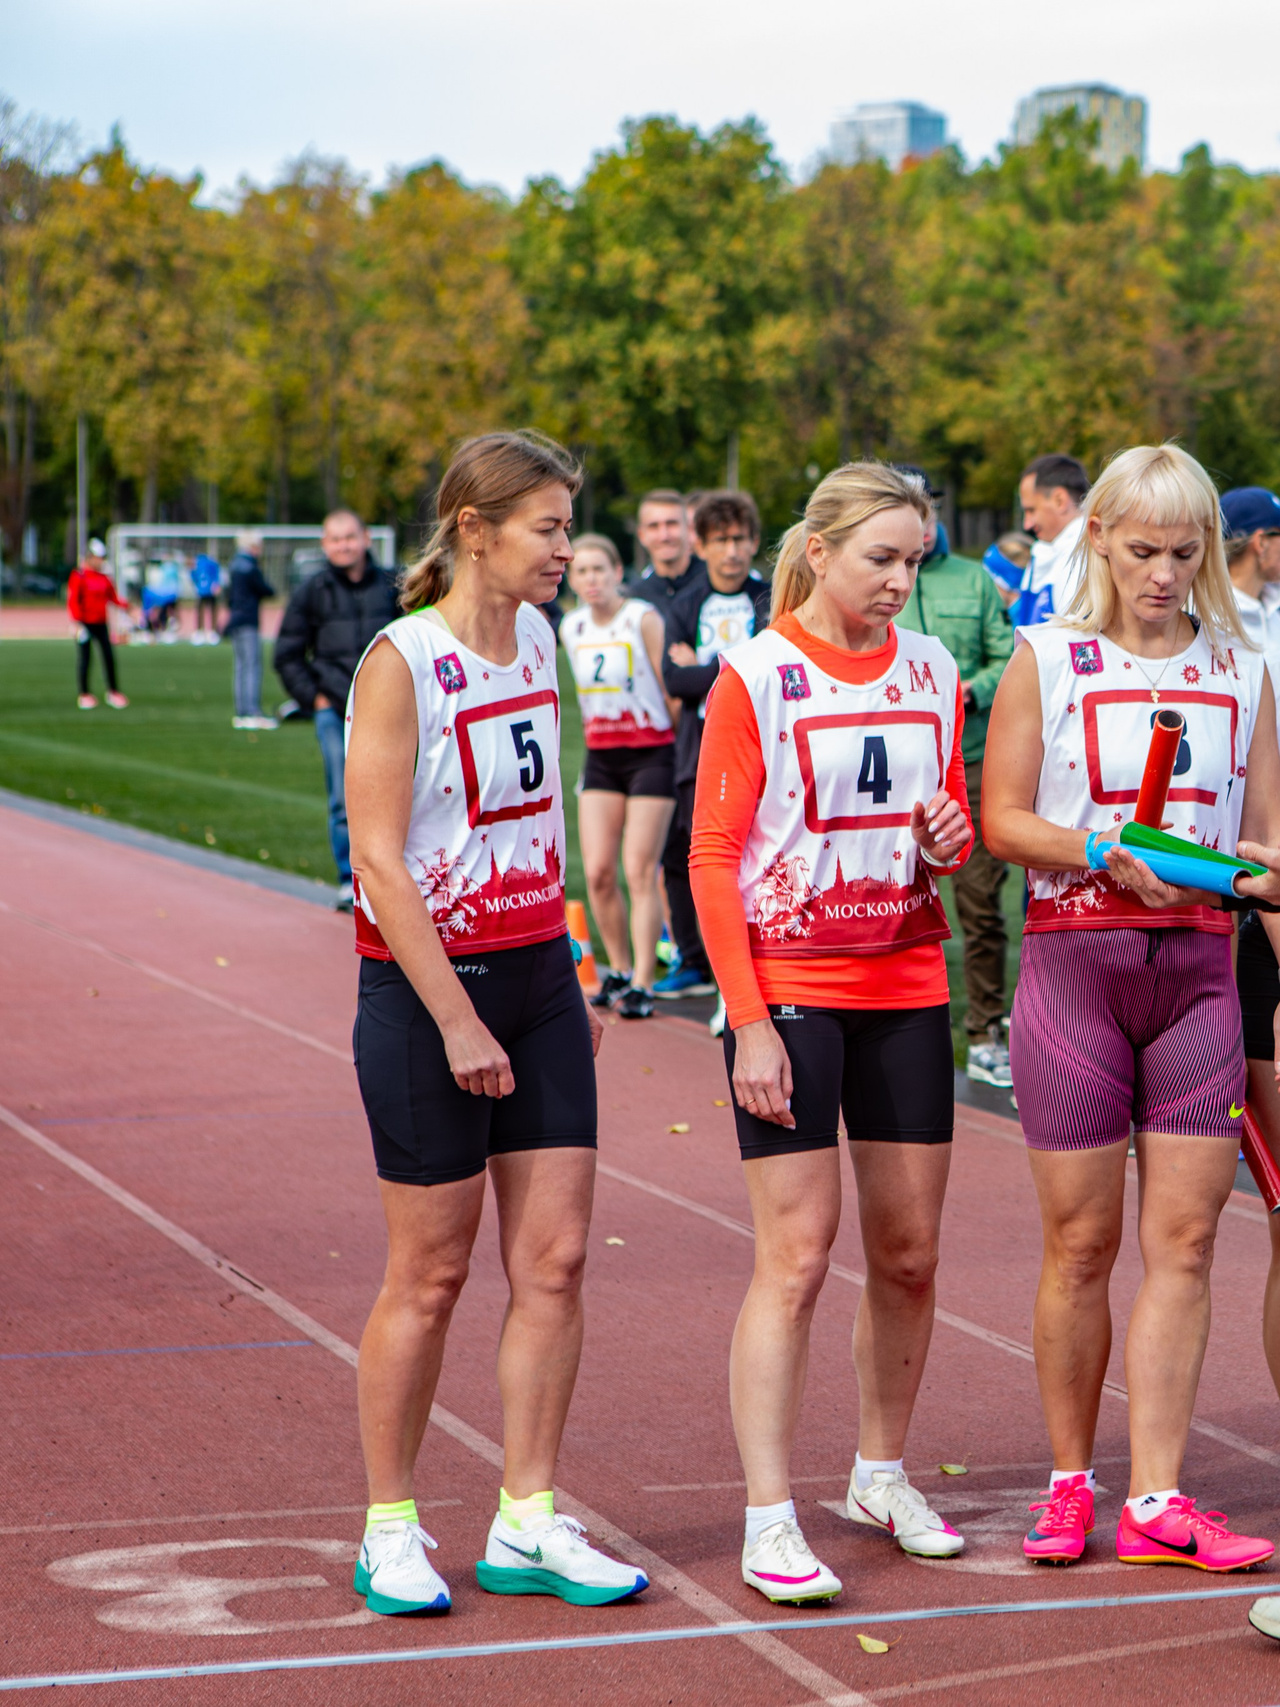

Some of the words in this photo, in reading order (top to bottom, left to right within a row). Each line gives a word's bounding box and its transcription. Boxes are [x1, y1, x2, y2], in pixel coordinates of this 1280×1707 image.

[594, 653, 605, 682] 2
[510, 720, 544, 793] 5
[857, 736, 892, 804] 4
